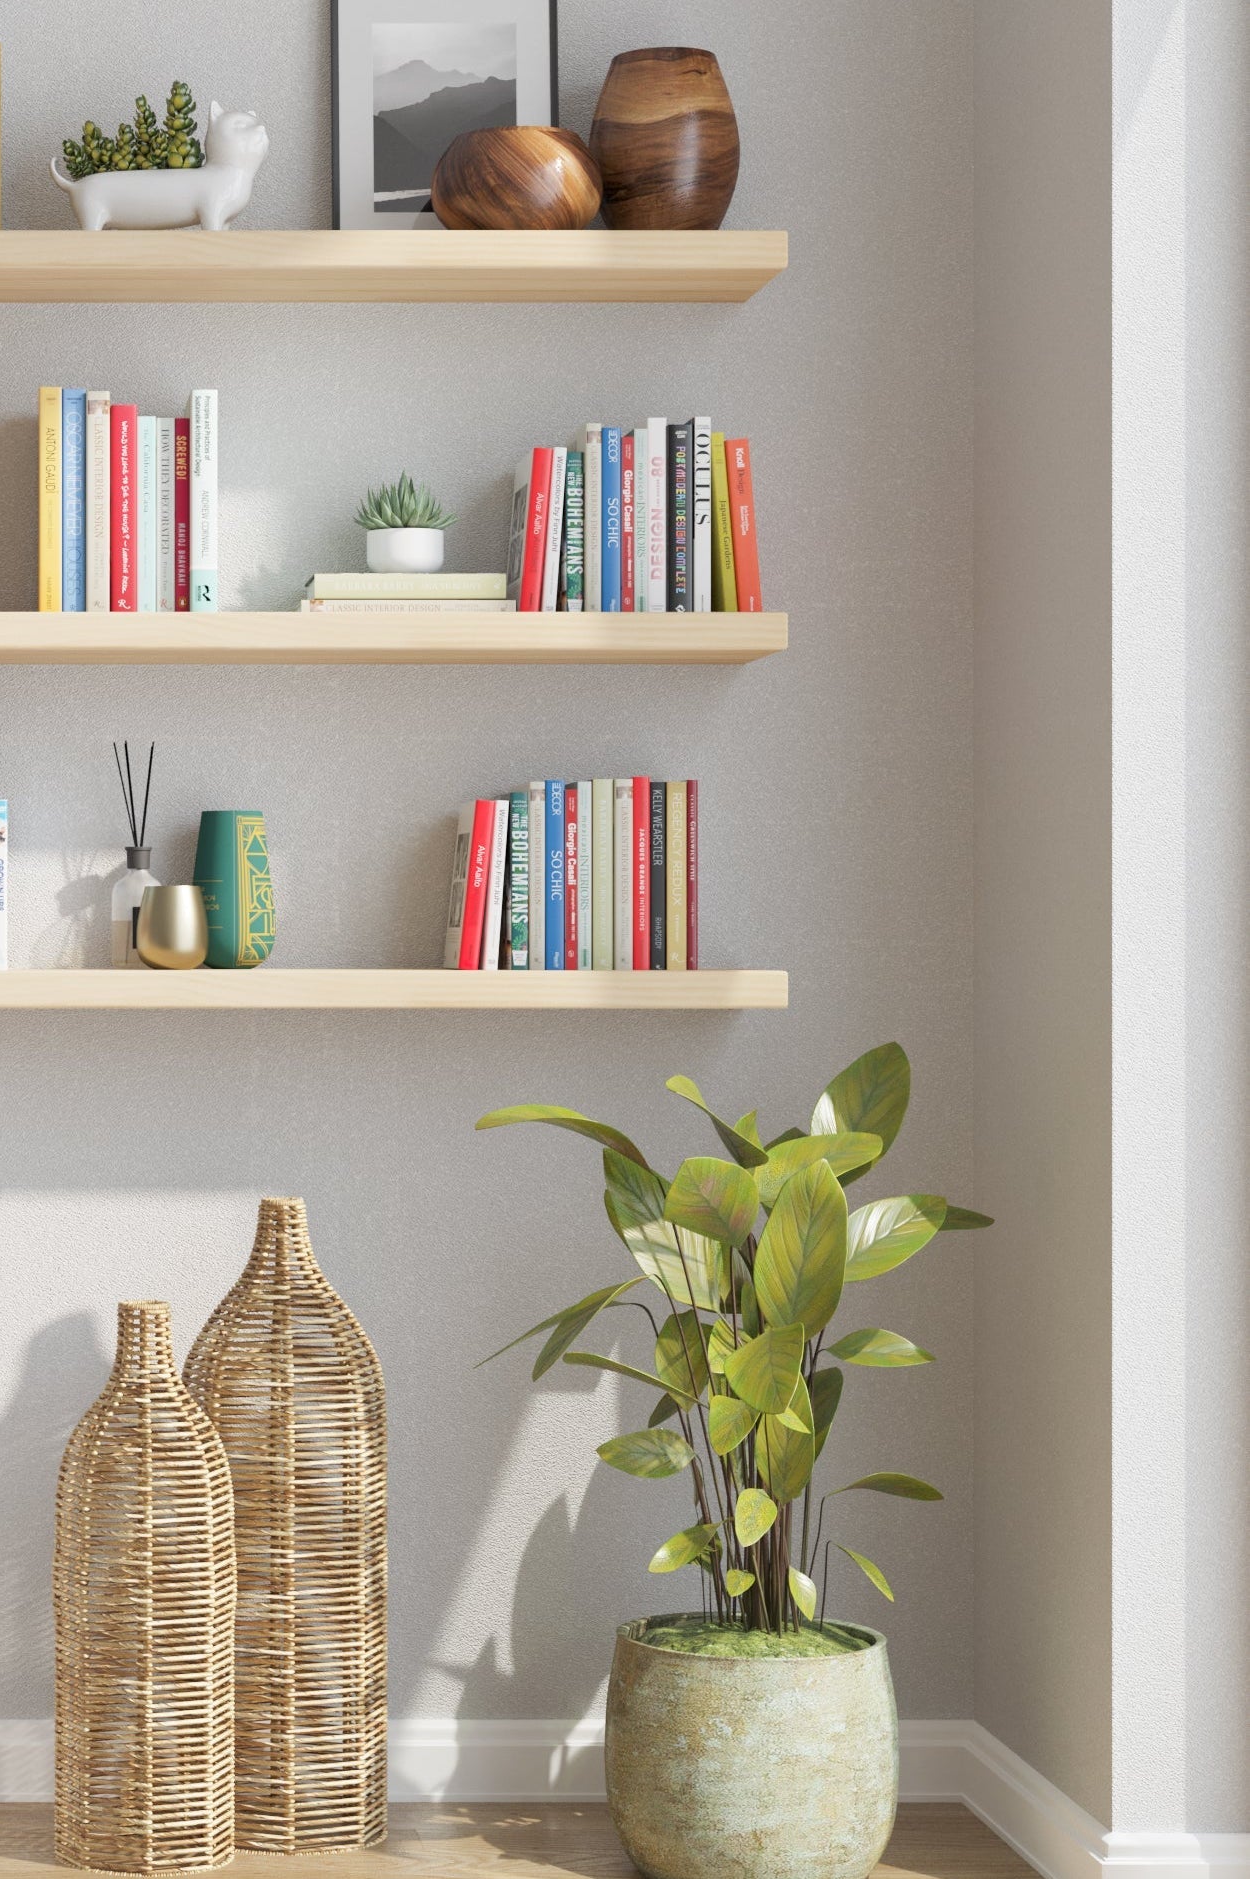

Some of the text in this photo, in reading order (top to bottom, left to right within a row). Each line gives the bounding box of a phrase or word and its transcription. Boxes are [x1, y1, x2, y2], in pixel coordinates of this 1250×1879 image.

[45, 427, 56, 462] ANTONI
[160, 428, 170, 456] HOW
[193, 396, 202, 458] Sustainable Architectural
[608, 435, 618, 463] DECOR
[142, 444, 152, 490] California
[160, 457, 170, 485] THEY
[176, 435, 187, 480] SCREWED!
[695, 432, 710, 525] OCULUS
[736, 448, 745, 468] Knoll
[66, 412, 83, 596] OSCAR NIEMEYER HOUSES
[201, 490, 210, 518] ANDREW
[534, 492, 544, 512] Alvar
[552, 456, 564, 534] Watercolors by Finn
[624, 470, 633, 504] Giorgio
[94, 503, 104, 538] DESIGN
[160, 490, 170, 555] DECORATED
[567, 488, 583, 574] BOHEMIANS
[608, 497, 618, 548] SO CHIC
[624, 505, 633, 532] Casali
[636, 501, 646, 558] INTERIORS
[650, 456, 664, 580] DESIGN 80
[675, 446, 686, 593] POSTMODERN DESIGN COMPLETE
[719, 500, 732, 570] Japanese Gardens
[552, 788, 562, 816] DECOR
[672, 792, 683, 857] REGENCY
[494, 810, 505, 870] Watercolors by
[566, 822, 576, 885] Giorgio Casali
[474, 845, 486, 888] Alvar Aalto
[512, 830, 528, 924] BOHEMIANS
[551, 850, 562, 901] SO CHIC
[580, 854, 590, 911] INTERIORS
[620, 874, 630, 904] DESIGN
[638, 828, 646, 931] JACQUES GRANGE INTERIORS
[652, 789, 663, 949] KELLY WEARSTLER RHAPSODY
[672, 860, 683, 906] REDUX
